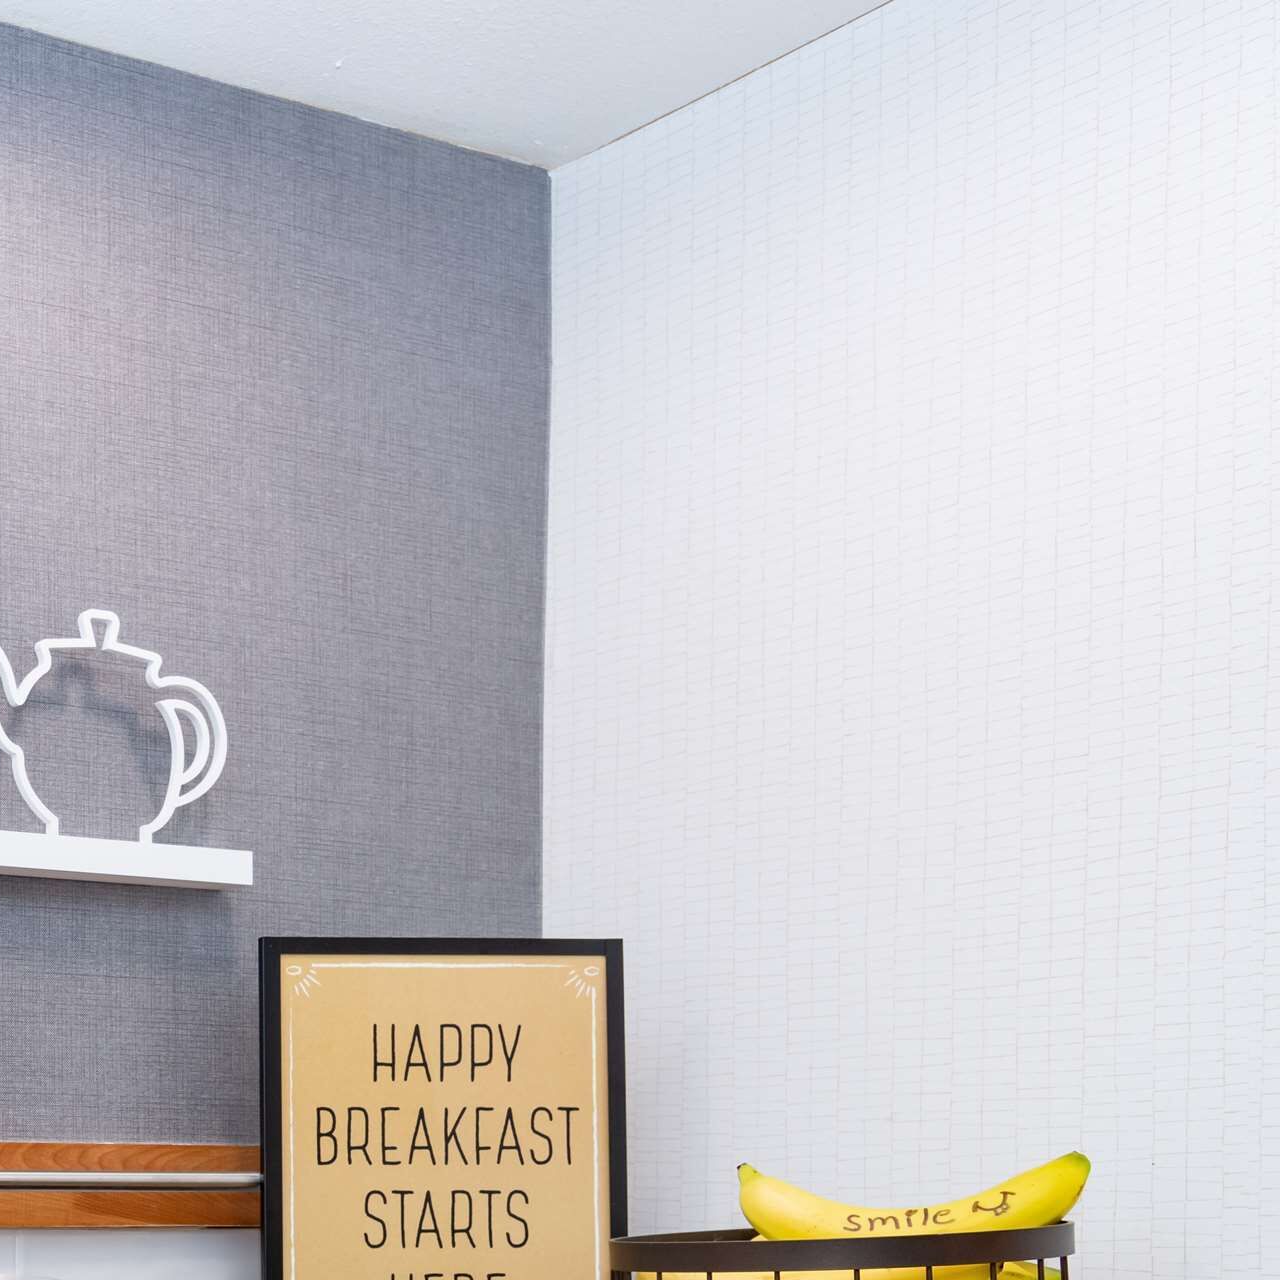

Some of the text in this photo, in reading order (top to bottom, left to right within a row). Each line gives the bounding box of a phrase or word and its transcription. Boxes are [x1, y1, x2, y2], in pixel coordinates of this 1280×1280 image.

[372, 1023, 522, 1083] HAPPY
[314, 1105, 580, 1167] BREAKFAST
[362, 1189, 530, 1250] STARTS
[842, 1207, 956, 1233] smile
